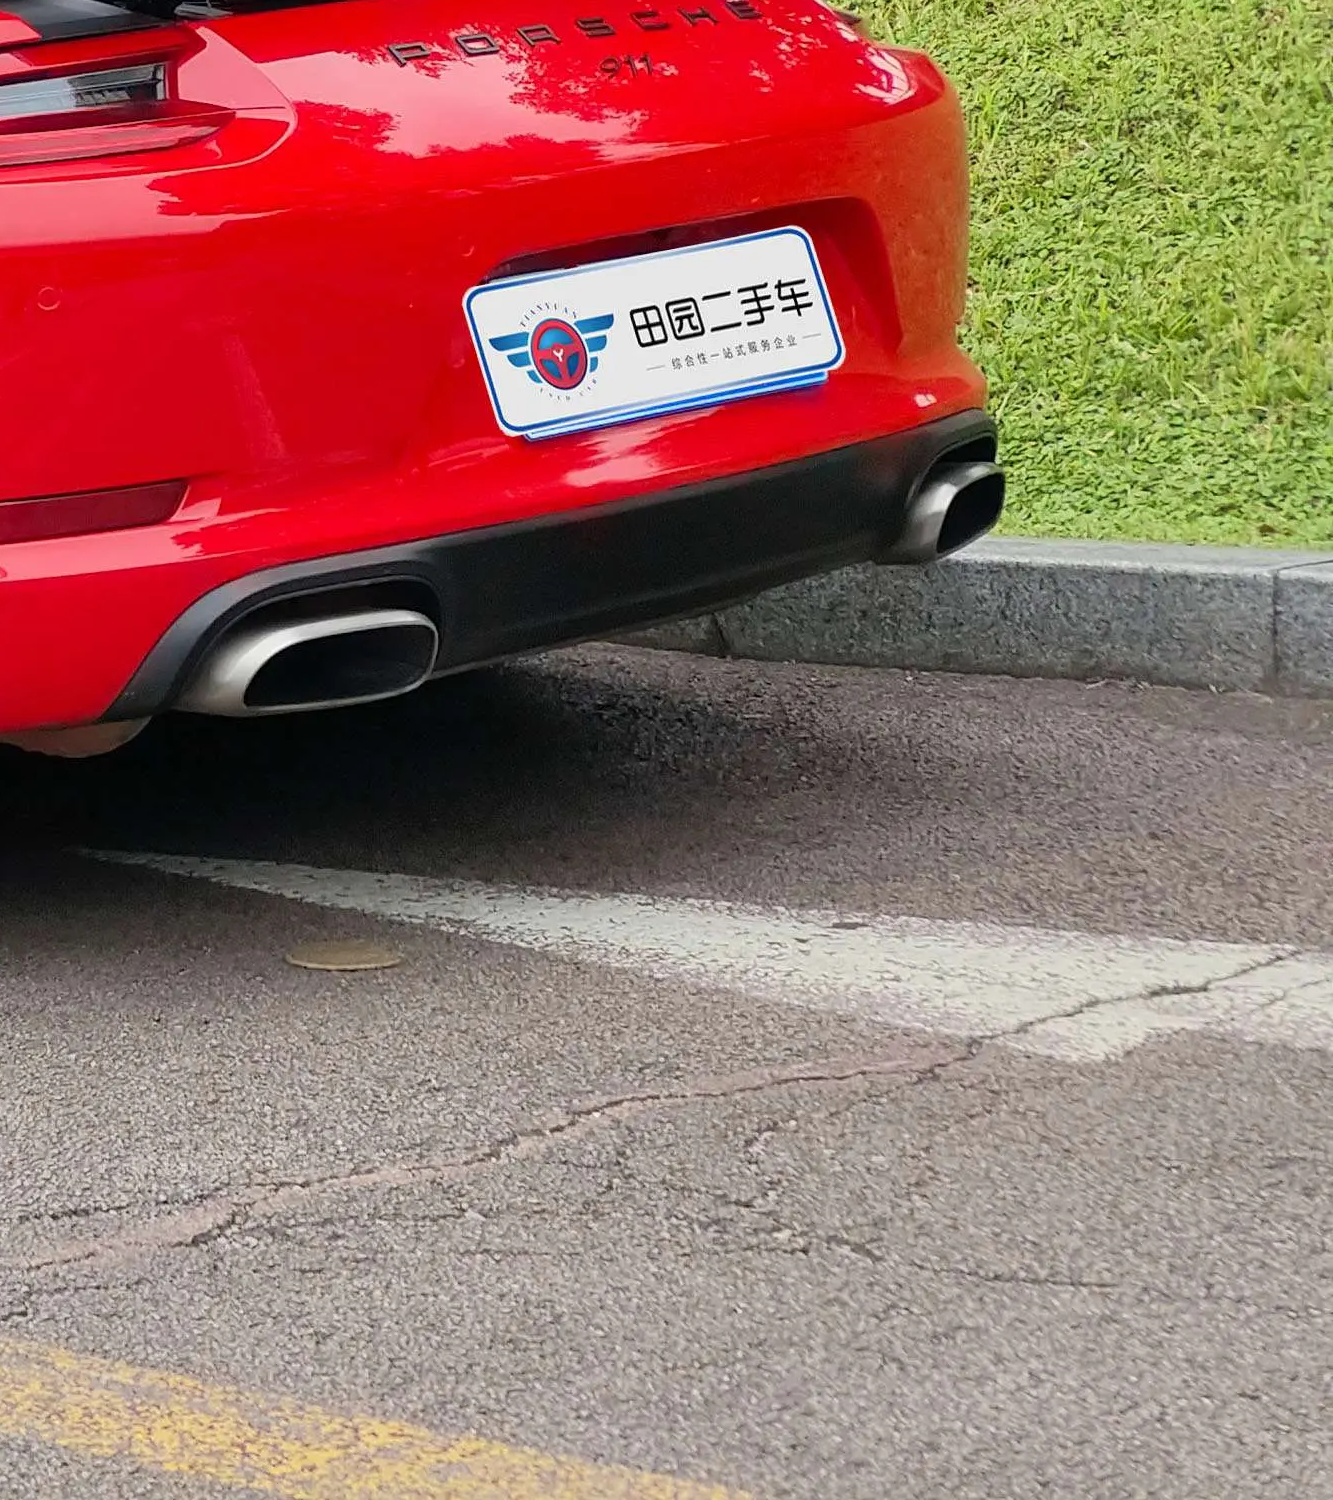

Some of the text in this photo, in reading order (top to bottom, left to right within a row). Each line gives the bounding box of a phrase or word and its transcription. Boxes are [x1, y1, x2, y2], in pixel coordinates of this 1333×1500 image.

[387, 0, 762, 67] PORSCHE
[599, 52, 654, 78] 911
[629, 277, 815, 349] 田园二手车
